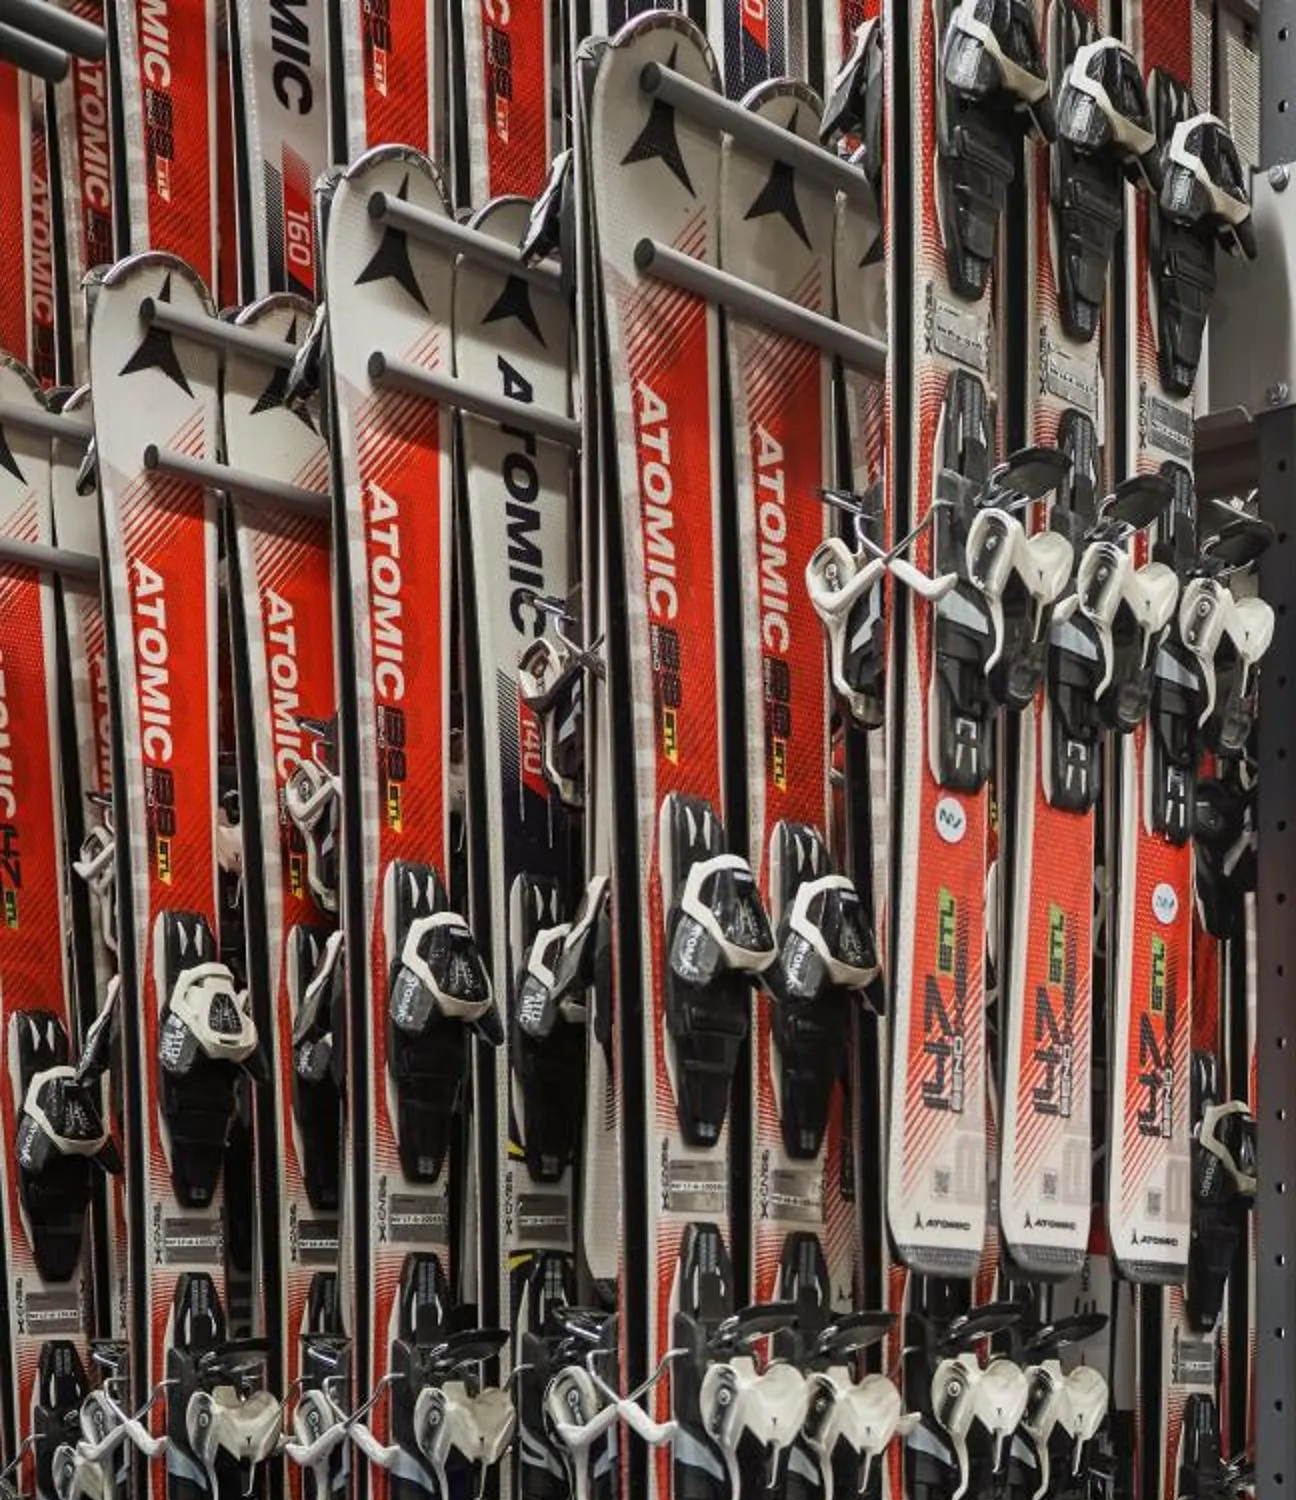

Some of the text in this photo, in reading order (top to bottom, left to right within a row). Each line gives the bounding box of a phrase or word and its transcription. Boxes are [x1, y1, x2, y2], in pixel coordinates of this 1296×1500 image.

[31, 172, 54, 326] ATOMIC
[286, 209, 313, 268] 160
[496, 354, 547, 637] ATOMIC
[636, 381, 680, 621] ATOMIC
[755, 424, 791, 654] ATOMIC
[366, 480, 406, 701] ATOMIC
[133, 558, 174, 763] ATOMIC
[263, 587, 301, 788] ATOMIC
[937, 900, 956, 975] ETL
[1048, 908, 1067, 986] ETL
[1151, 940, 1167, 1013] ETL
[924, 1216, 972, 1233] ATOMIC
[1033, 1216, 1078, 1232] ATOMIC
[1139, 1234, 1179, 1249] ATOMIC
